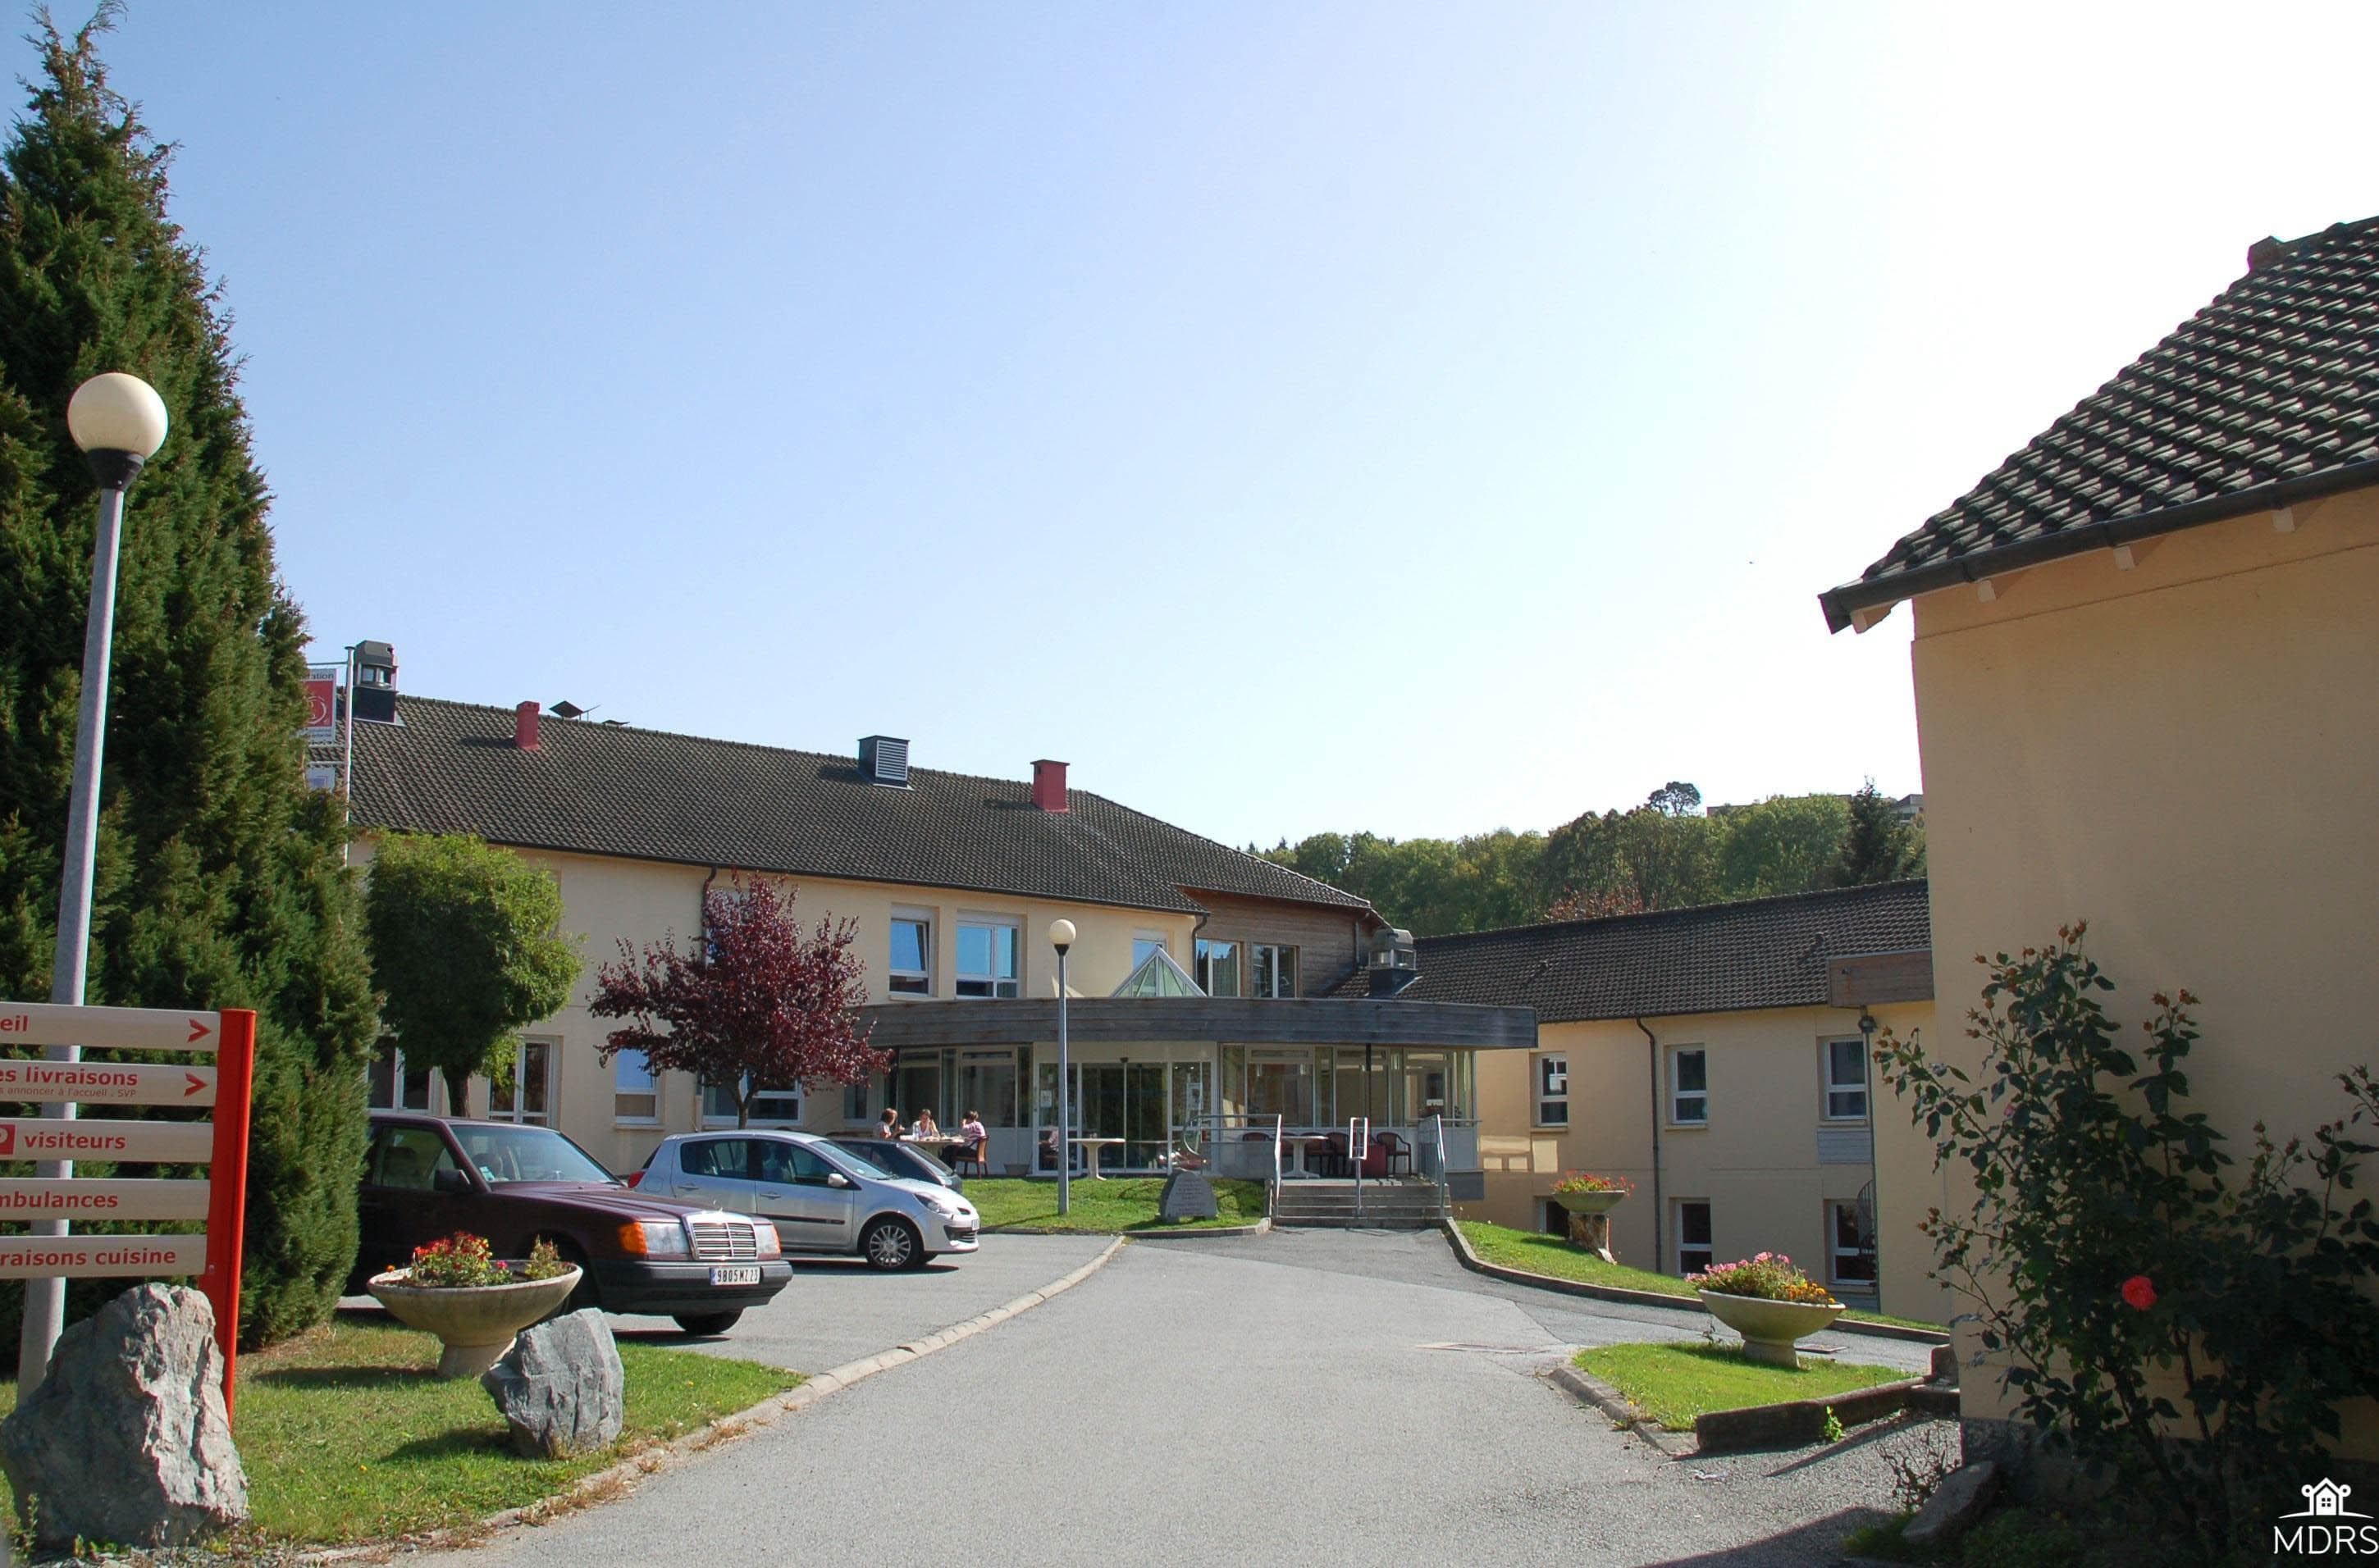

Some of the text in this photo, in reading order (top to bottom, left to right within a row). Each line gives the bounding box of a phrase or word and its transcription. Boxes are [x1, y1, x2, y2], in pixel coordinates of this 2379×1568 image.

[0, 1014, 29, 1032] eil
[25, 1066, 138, 1086] livraisons
[7, 1087, 54, 1096] annoncer
[117, 1089, 136, 1097] SVP
[25, 1132, 126, 1150] visiteurs
[0, 1247, 176, 1267] raisons cuisine
